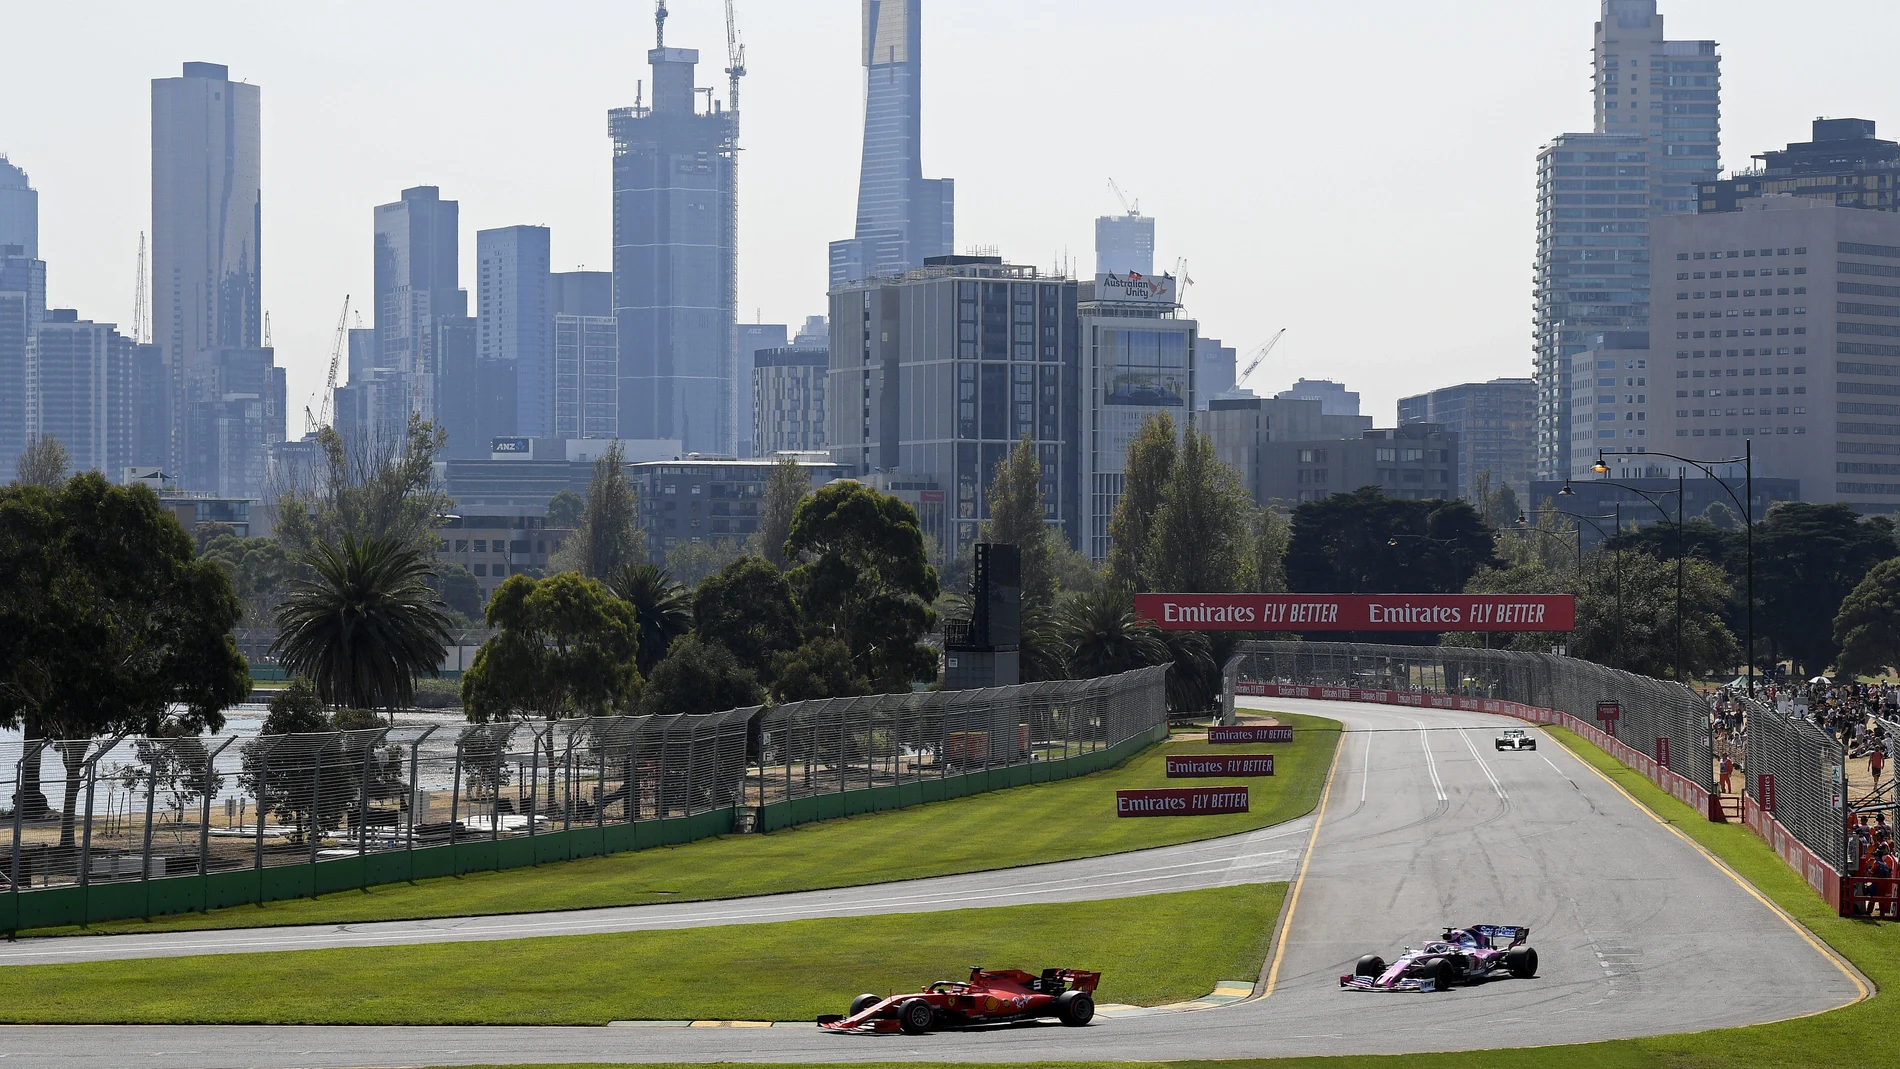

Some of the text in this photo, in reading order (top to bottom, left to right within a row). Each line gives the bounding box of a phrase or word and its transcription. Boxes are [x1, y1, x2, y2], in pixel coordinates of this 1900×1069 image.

[1103, 278, 1148, 288] Australian
[1125, 287, 1149, 299] Unity
[496, 443, 516, 451] ANZ
[1163, 602, 1338, 622] Emirates FLY BETTER
[1368, 603, 1545, 623] Emirates FLY BETTER
[1209, 729, 1292, 740] Emirates FLY BETTER
[1167, 759, 1273, 773] Emirates FLY BETTER
[1118, 792, 1247, 812] Emirates FLY BETTER
[1831, 794, 1840, 807] F
[1033, 979, 1042, 990] 5
